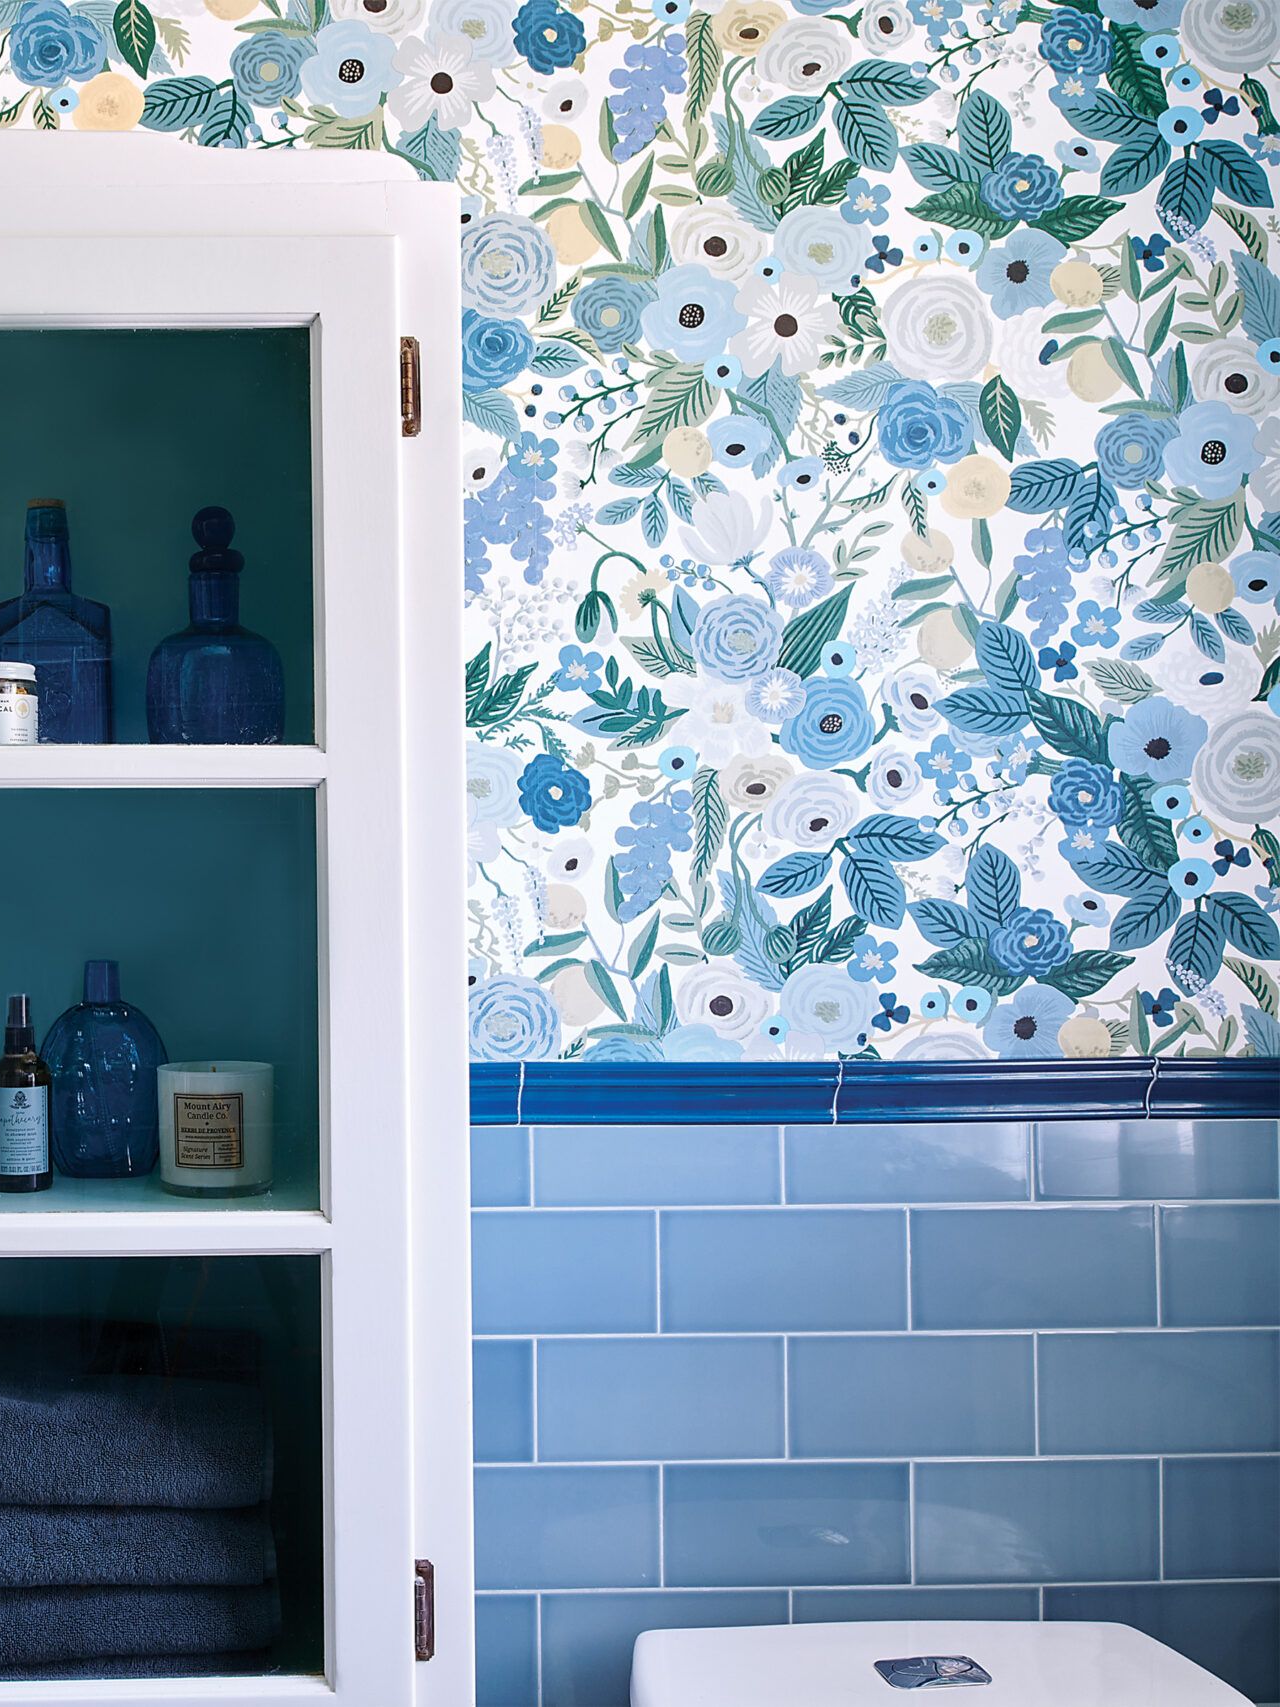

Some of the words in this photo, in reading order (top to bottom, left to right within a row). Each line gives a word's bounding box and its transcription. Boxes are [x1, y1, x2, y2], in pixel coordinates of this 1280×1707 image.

[184, 1102, 210, 1110] Mount
[212, 1102, 231, 1112] Airy
[187, 1112, 214, 1120] Candle
